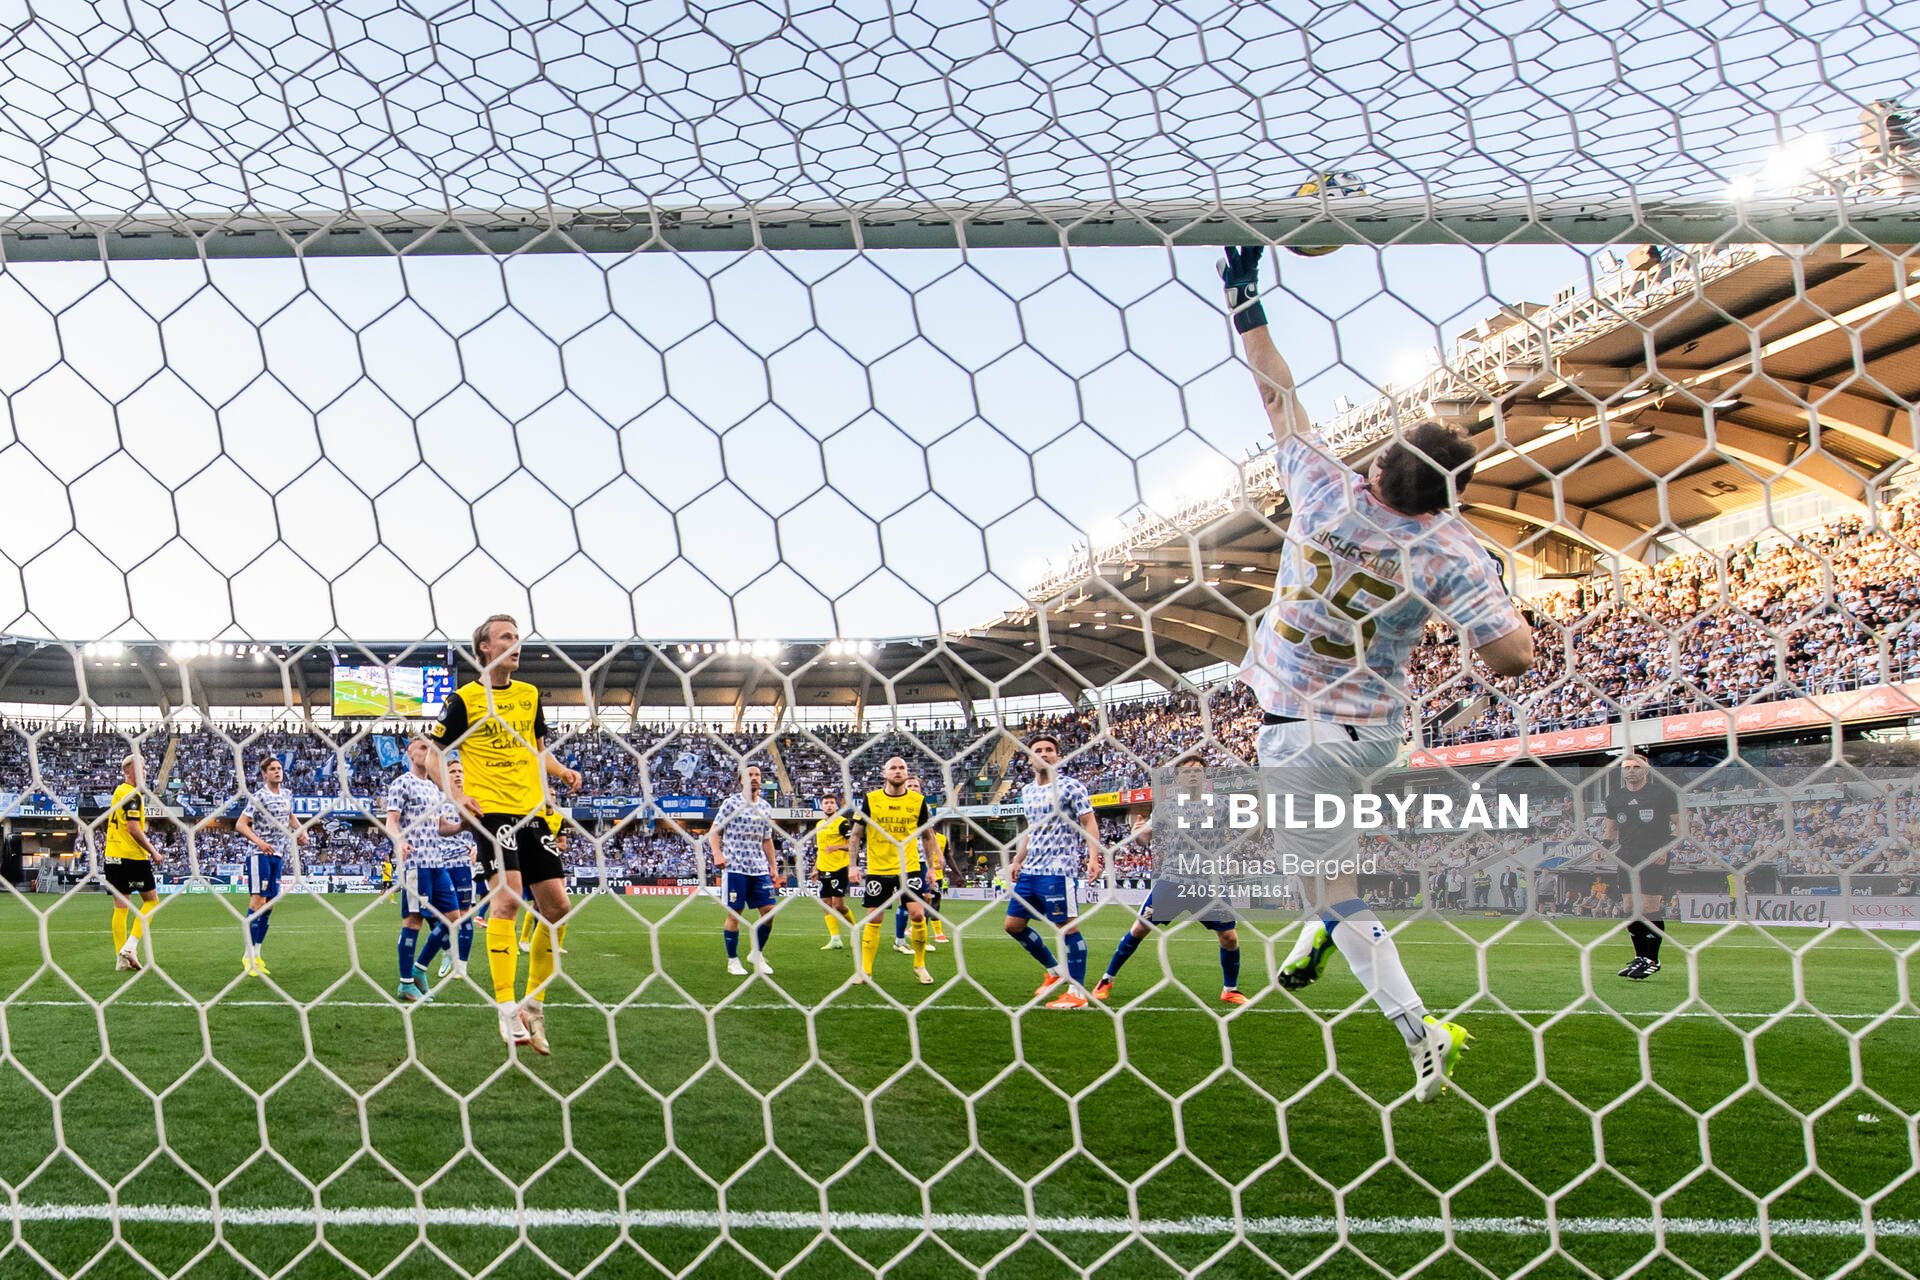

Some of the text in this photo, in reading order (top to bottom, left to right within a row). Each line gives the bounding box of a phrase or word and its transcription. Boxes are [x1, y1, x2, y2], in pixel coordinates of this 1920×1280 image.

[633, 887, 690, 896] BAUHAUS
[1755, 899, 1826, 923] Kakel
[1852, 904, 1916, 917] KOCK
